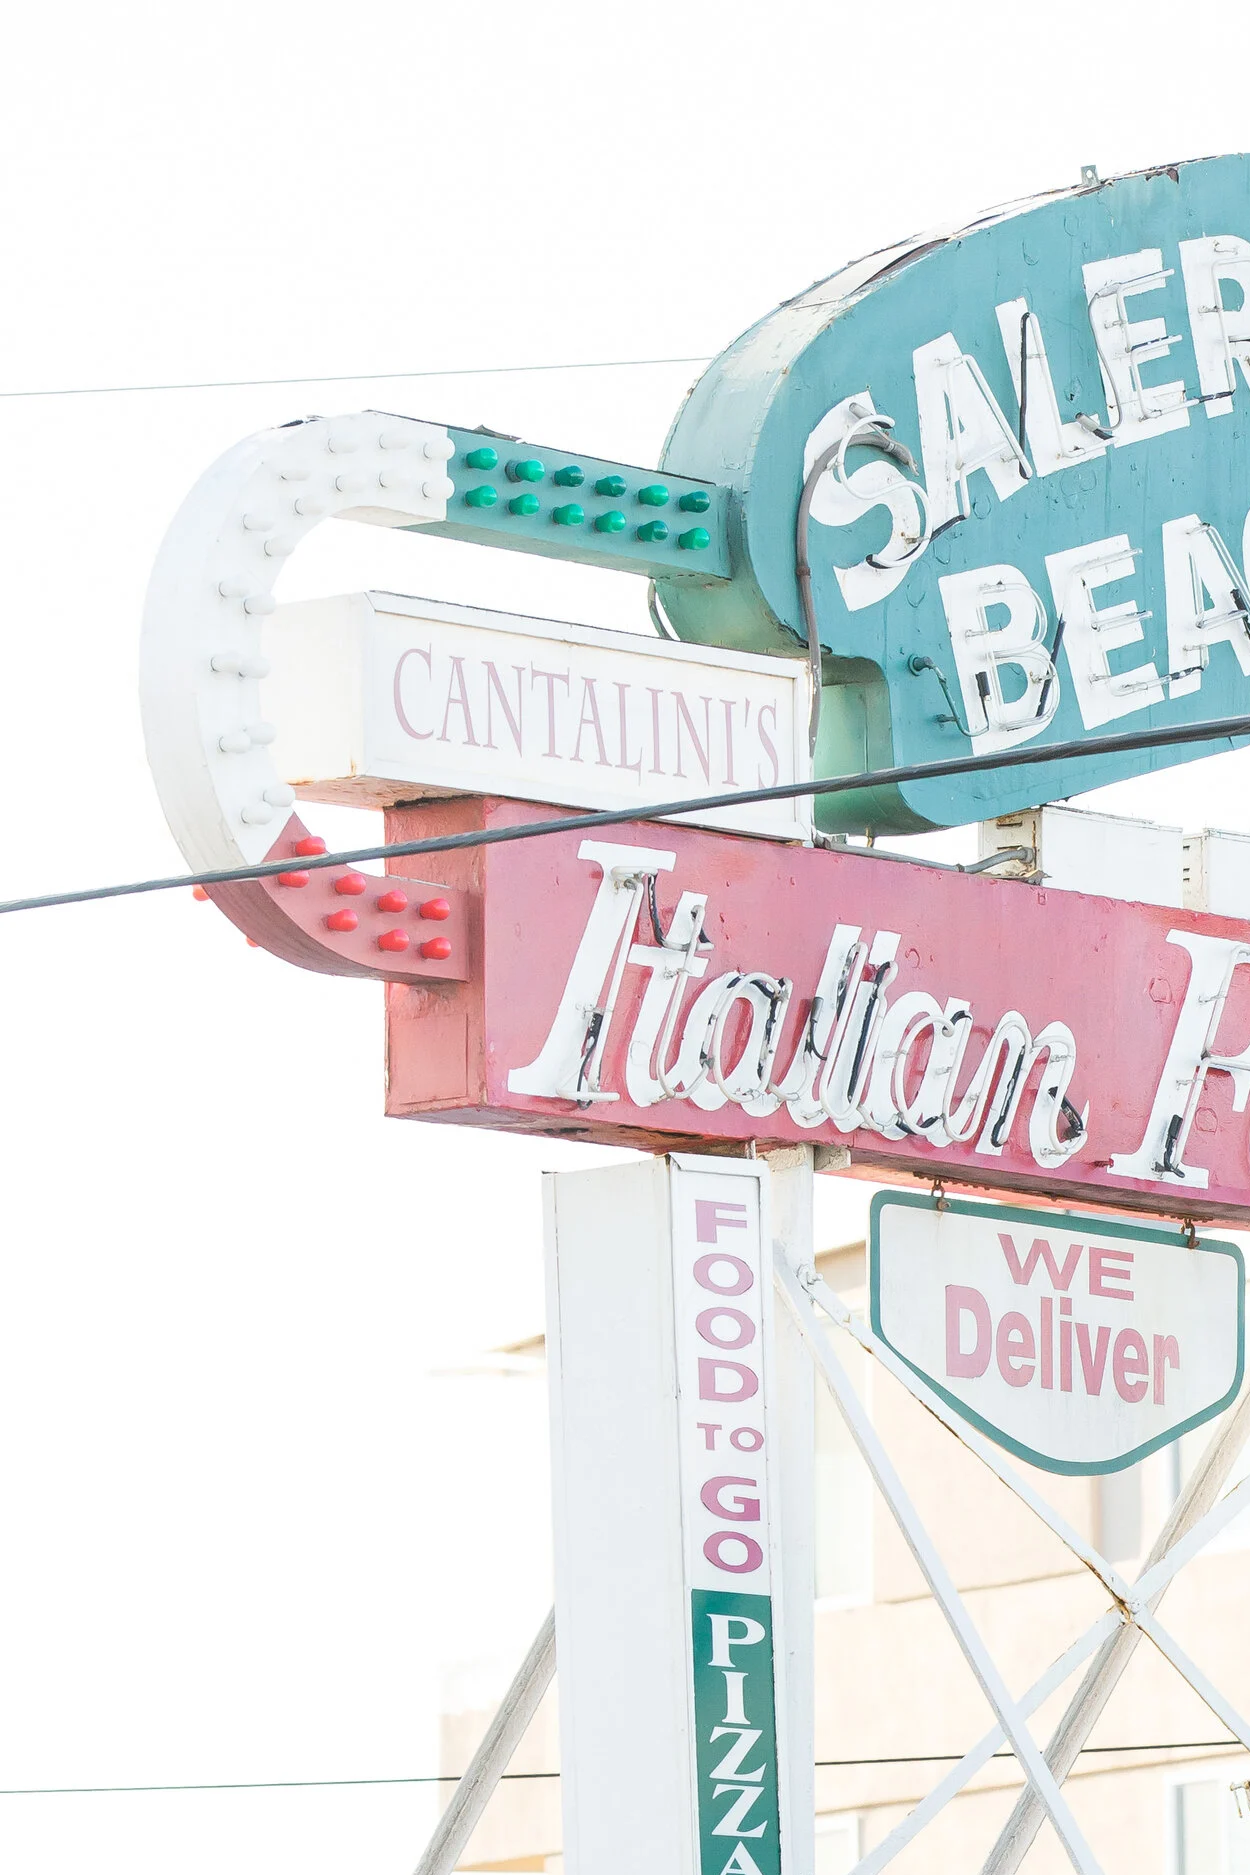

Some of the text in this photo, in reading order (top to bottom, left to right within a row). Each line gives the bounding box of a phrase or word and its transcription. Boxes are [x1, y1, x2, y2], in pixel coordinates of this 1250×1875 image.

[393, 643, 780, 789] CANTALINI'S
[508, 840, 1088, 1169] Italian
[997, 1233, 1135, 1301] WE
[693, 1200, 764, 1573] FOOD TO GO
[945, 1284, 1180, 1405] Deliver
